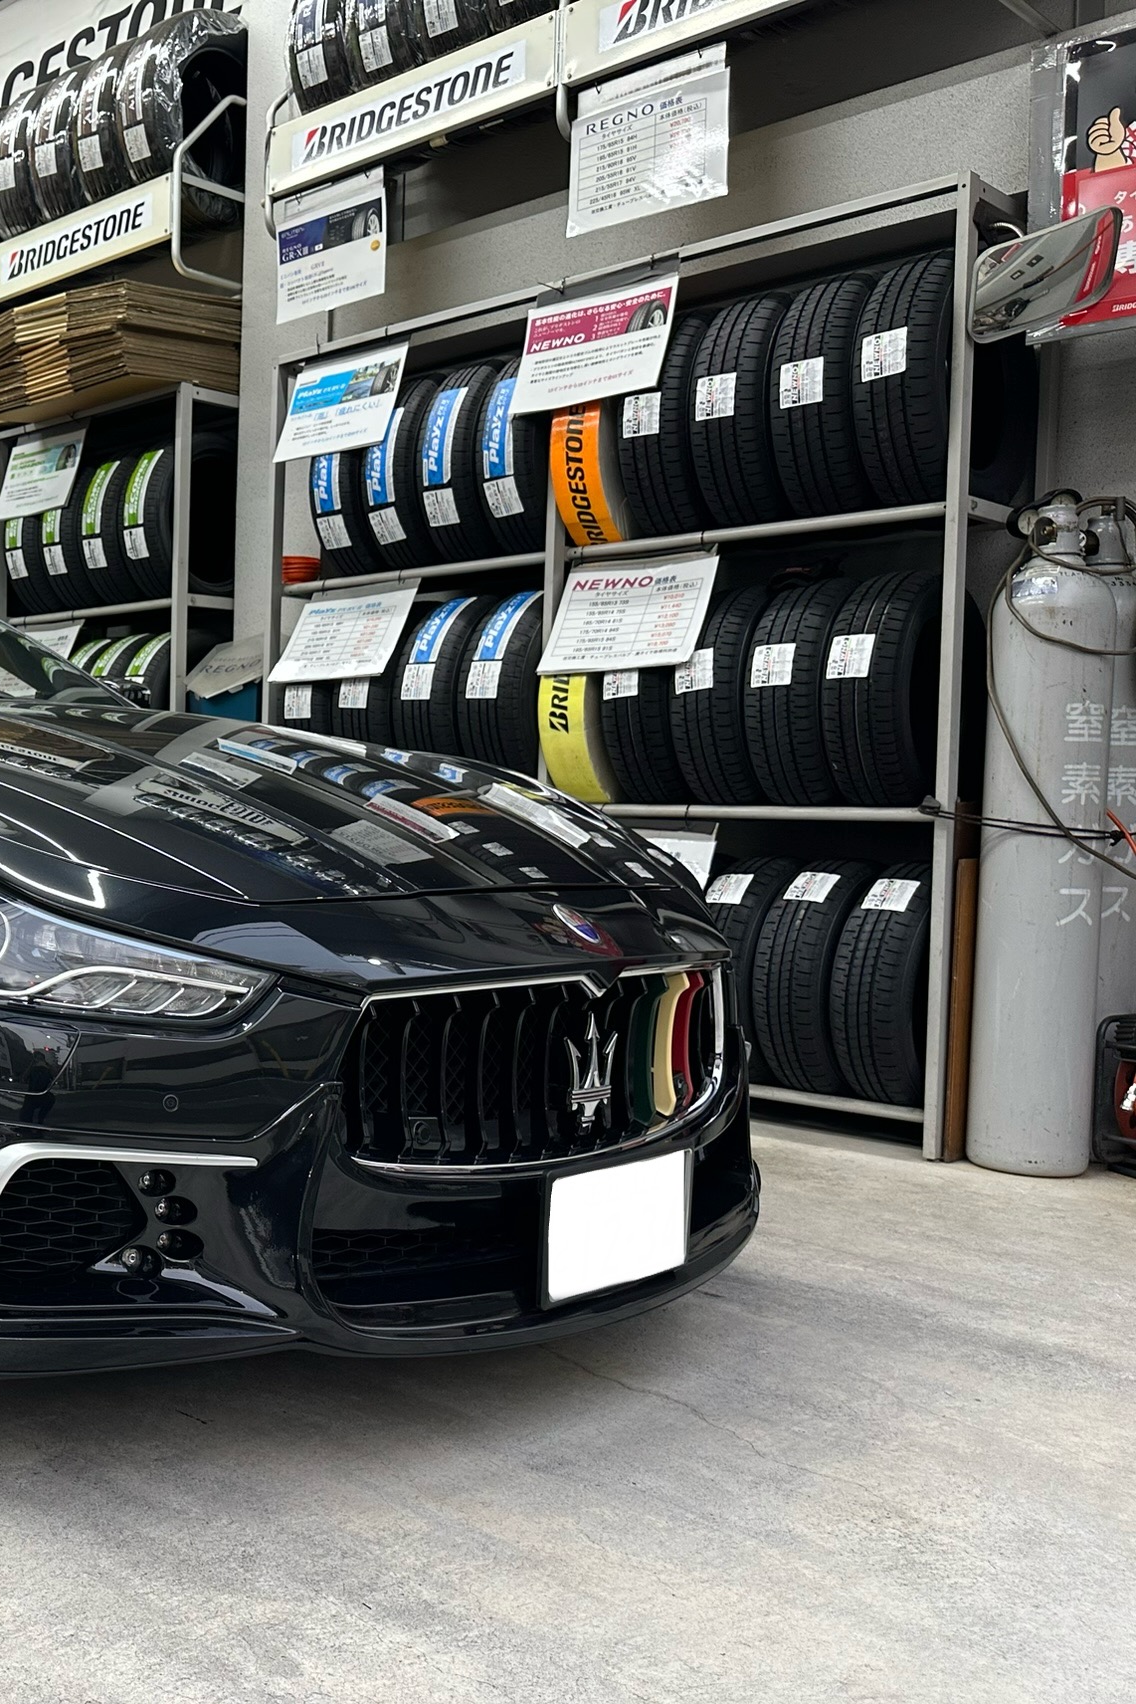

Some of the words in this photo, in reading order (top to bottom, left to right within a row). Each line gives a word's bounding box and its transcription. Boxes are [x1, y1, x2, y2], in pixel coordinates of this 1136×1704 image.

[304, 51, 515, 162] BRIDGESTONE
[586, 103, 655, 136] REGNO
[7, 201, 146, 281] BRIDGESTONE
[530, 333, 585, 352] NEWNO
[428, 411, 446, 472] Playz
[489, 404, 505, 465] Playz
[572, 576, 653, 591] NEWNO
[419, 608, 448, 652] Playz
[484, 604, 516, 649] Playz
